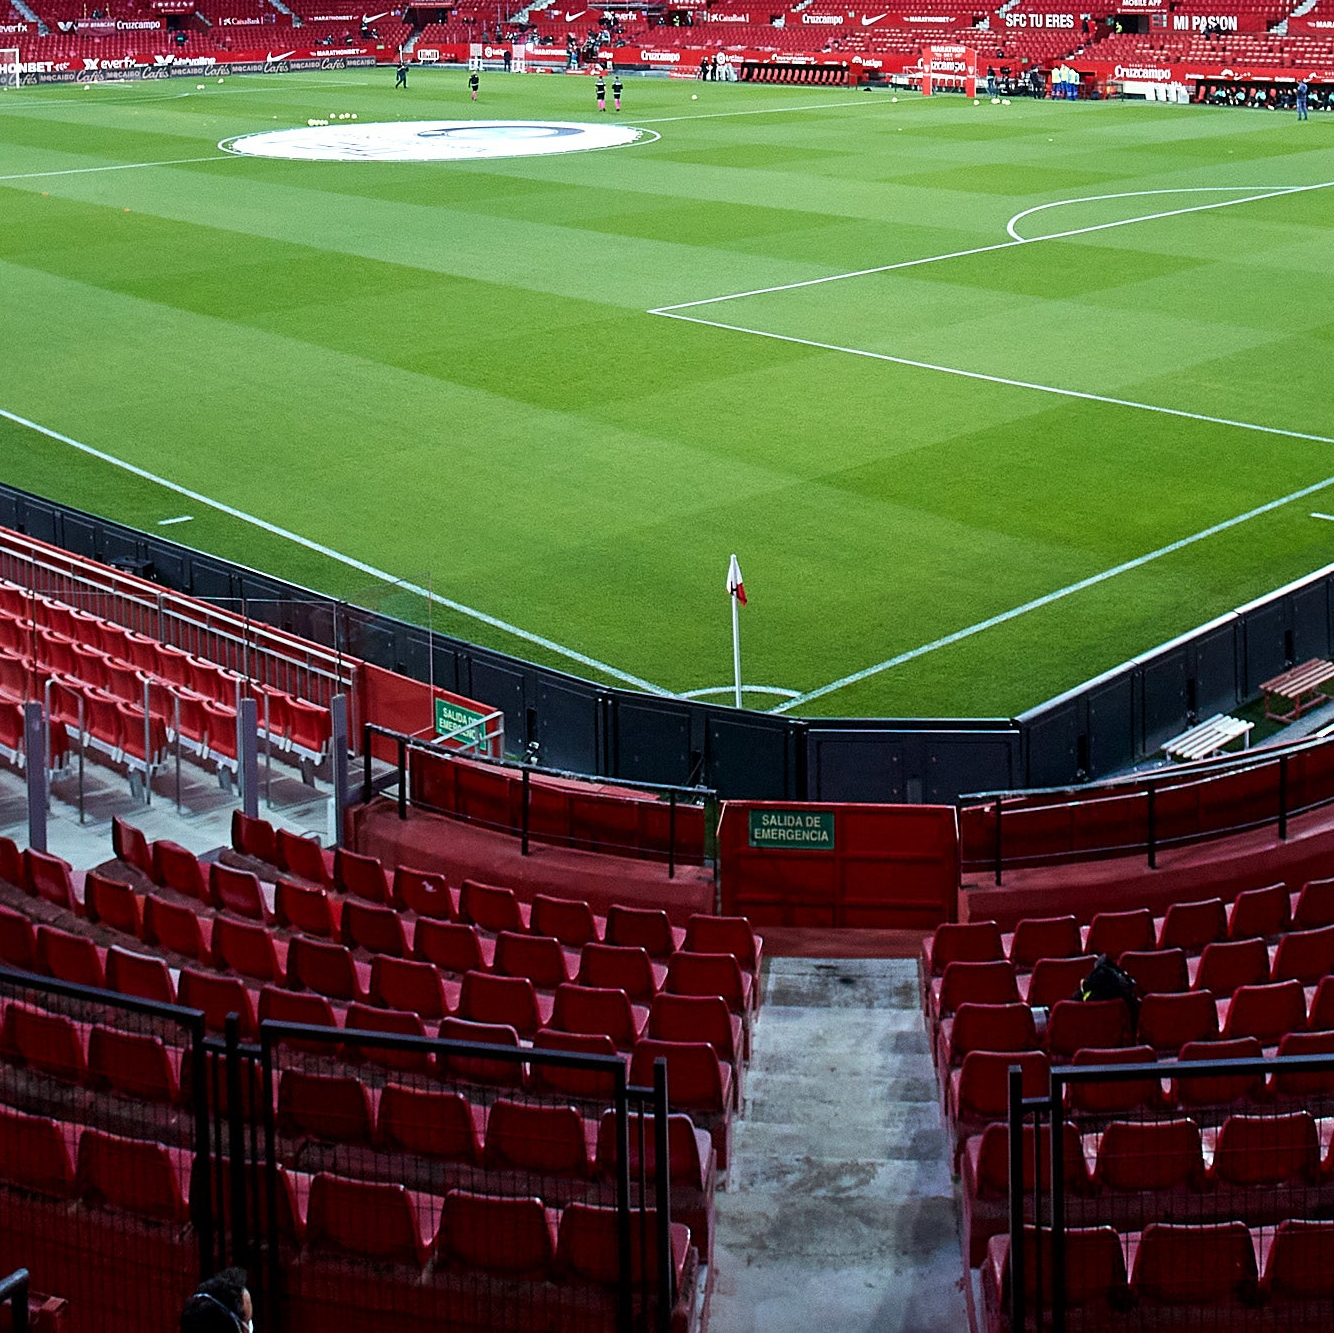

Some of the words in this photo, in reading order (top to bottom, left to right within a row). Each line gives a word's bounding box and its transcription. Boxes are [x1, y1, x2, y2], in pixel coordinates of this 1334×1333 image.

[116, 20, 161, 31] Cruzcampo
[231, 17, 260, 25] CaixaBank
[801, 14, 844, 26] Cruzcampo
[1005, 13, 1027, 28] SFC
[1028, 13, 1043, 28] TU
[1045, 13, 1075, 28] ERES
[1173, 15, 1190, 31] MI
[204, 63, 230, 76] Cafés
[264, 61, 289, 74] Cafés
[321, 58, 346, 70] Cafés
[76, 69, 104, 82] Cafés
[142, 66, 169, 80] Cafés
[1114, 65, 1171, 80] Cruzcampo
[442, 707, 467, 725] SALIDA
[761, 814, 803, 828] SALIDA
[805, 815, 821, 828] DE
[754, 828, 829, 842] EMERGENCIA
